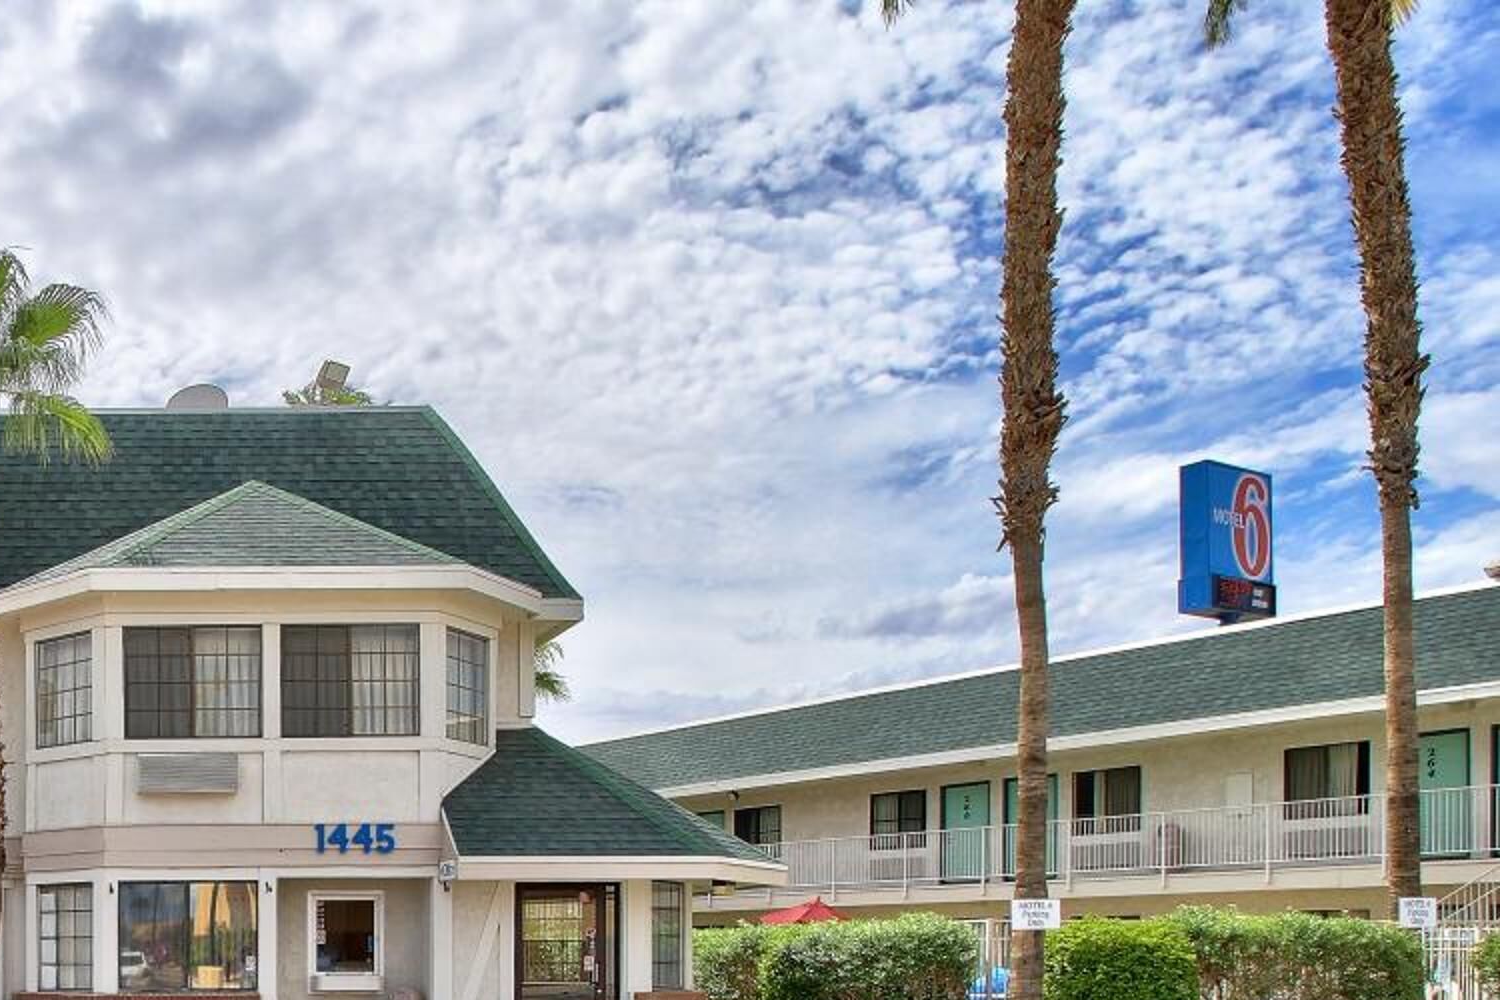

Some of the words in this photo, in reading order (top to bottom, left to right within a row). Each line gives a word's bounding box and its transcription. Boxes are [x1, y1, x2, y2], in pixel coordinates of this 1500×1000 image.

[1213, 508, 1245, 529] MOTEL
[1232, 474, 1270, 580] 6
[313, 823, 396, 854] 1445
